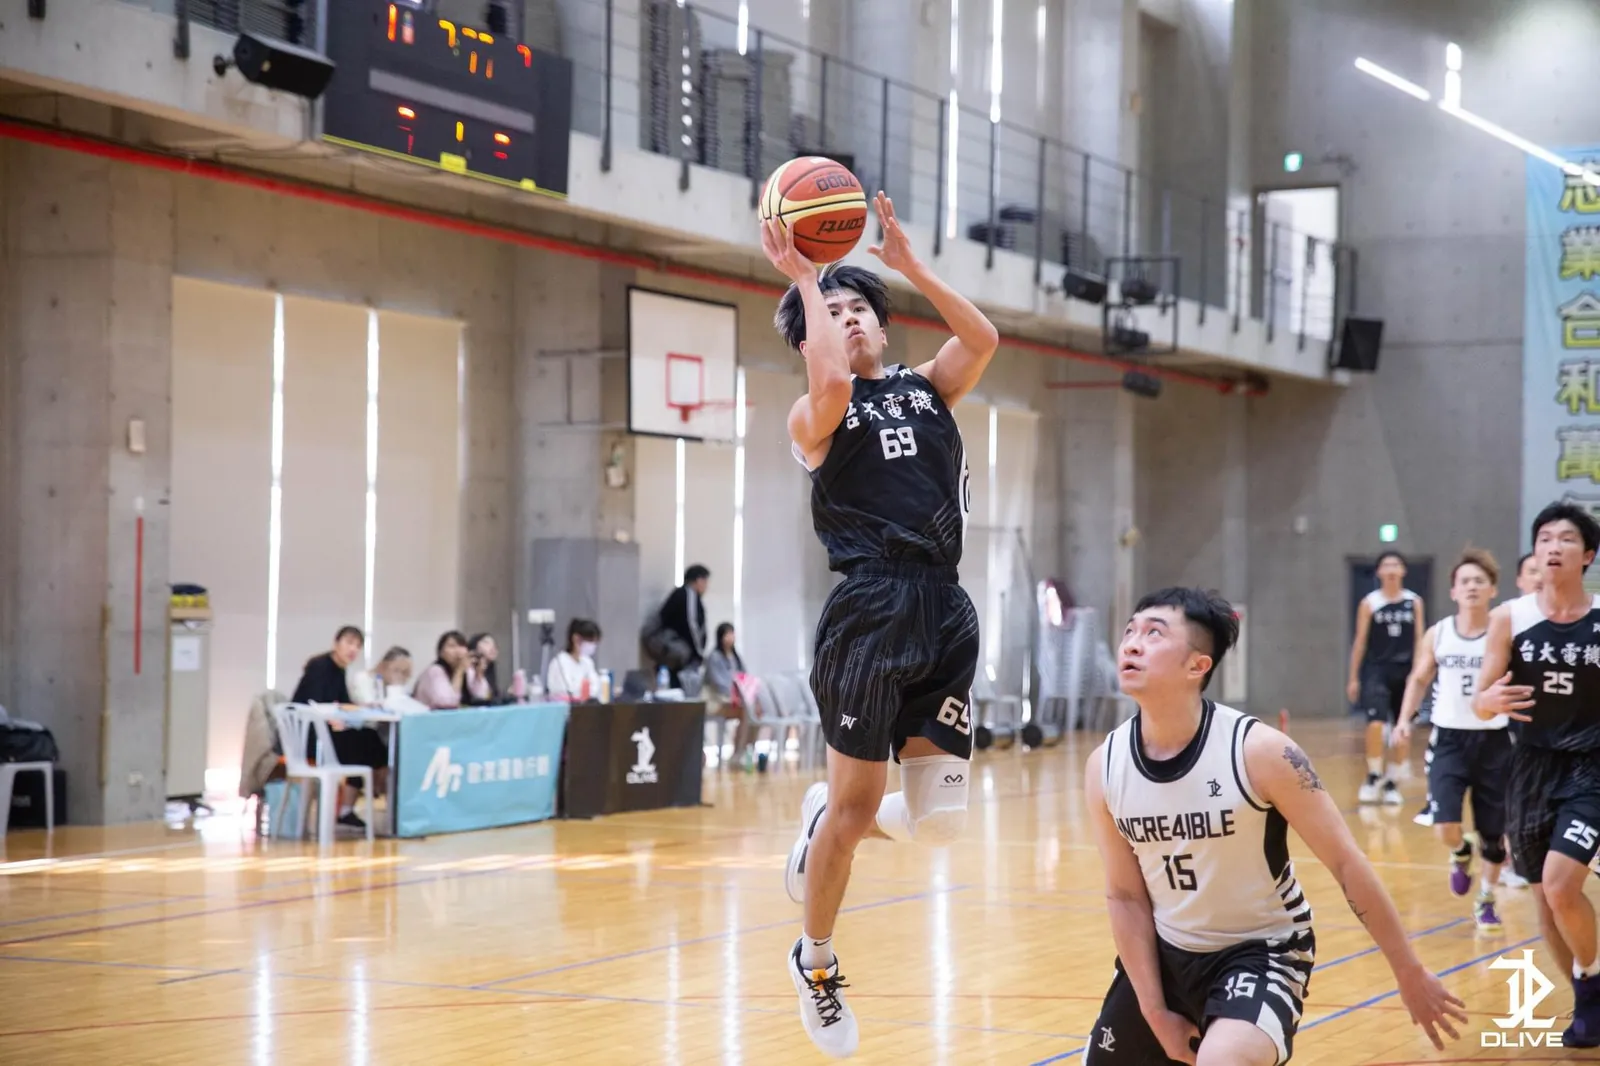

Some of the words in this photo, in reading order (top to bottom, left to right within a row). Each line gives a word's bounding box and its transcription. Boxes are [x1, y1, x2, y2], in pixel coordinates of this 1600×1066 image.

[815, 174, 857, 192] 7000
[846, 388, 938, 430] 台大電機
[878, 426, 918, 460] 69
[1543, 670, 1575, 695] 25
[1562, 819, 1599, 850] 25
[1162, 853, 1198, 892] 15
[1224, 972, 1259, 1001] 15
